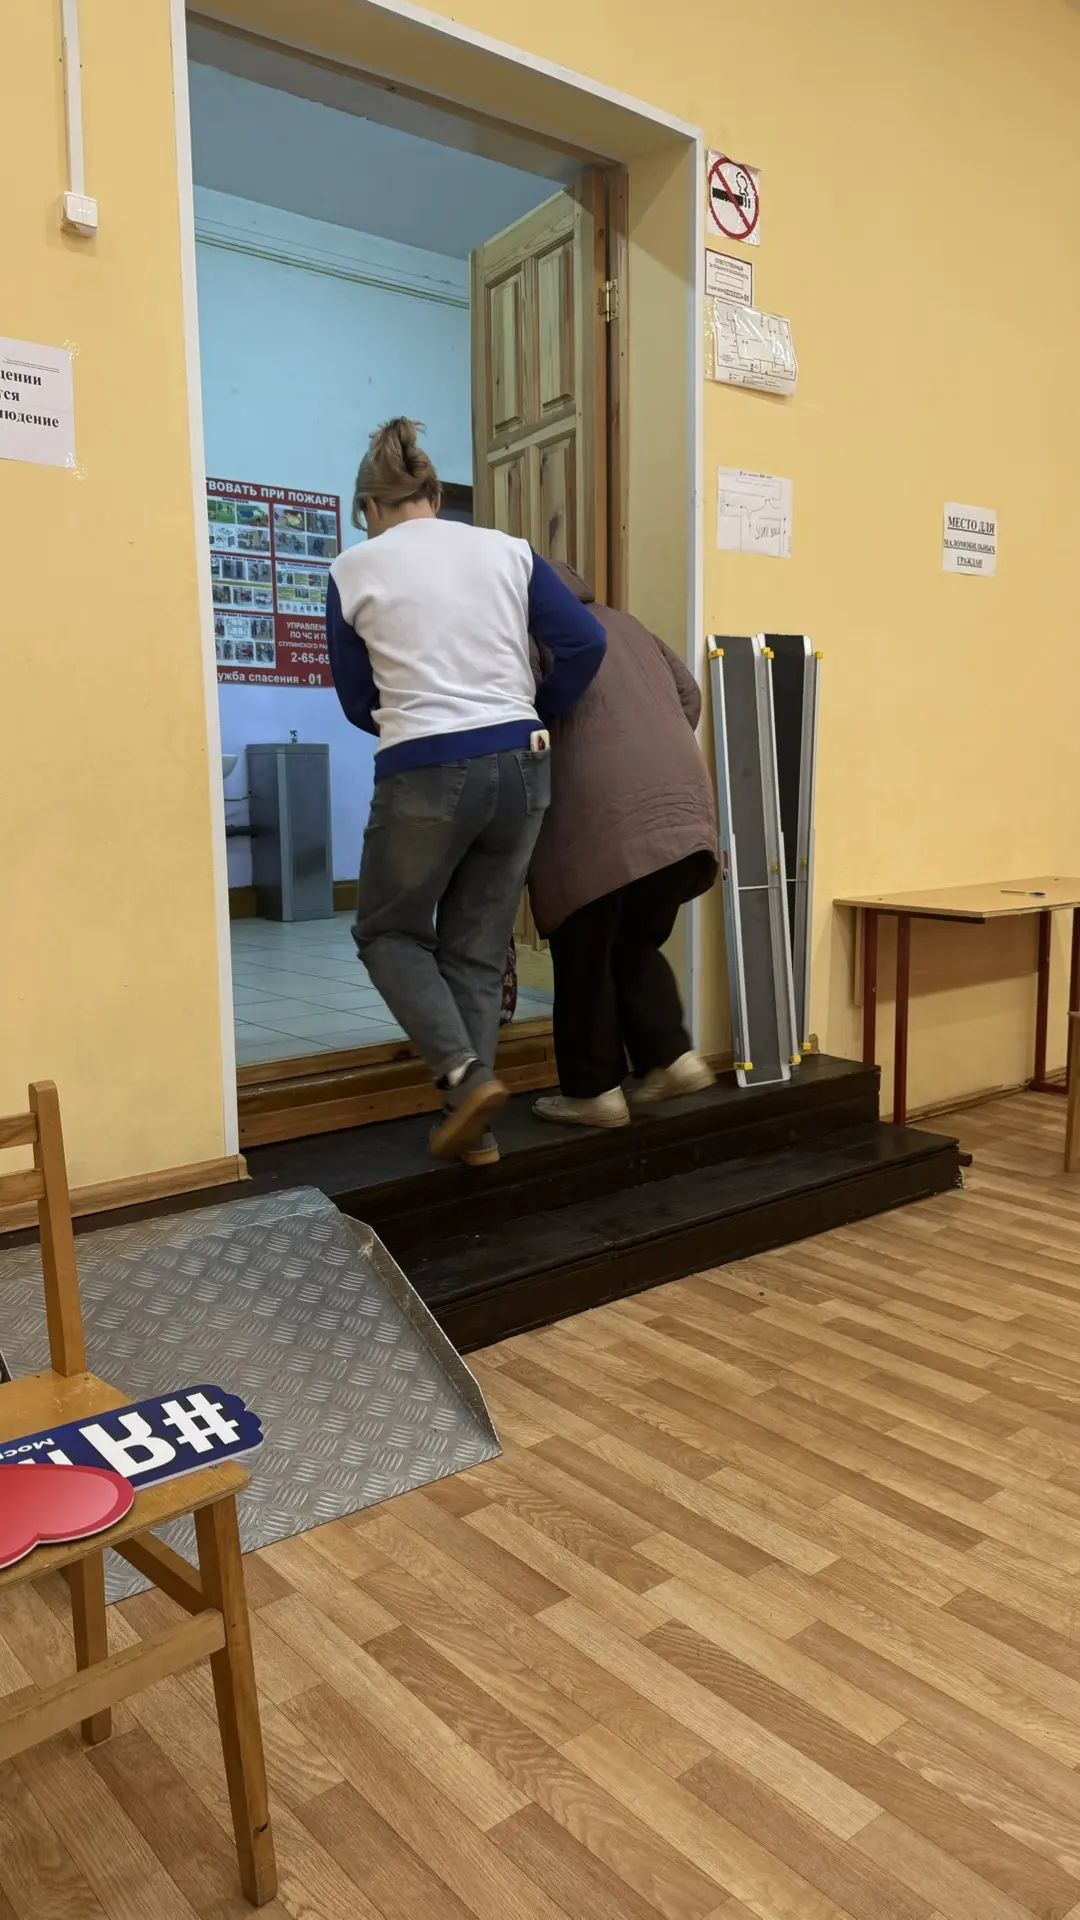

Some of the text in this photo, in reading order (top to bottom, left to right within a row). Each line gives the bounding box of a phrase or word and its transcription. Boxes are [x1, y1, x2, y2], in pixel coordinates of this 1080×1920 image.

[206, 480, 337, 507] ВОВАТЬ ПРИ ПОЖАРЕ
[948, 516, 995, 535] МЕСТО ДЛЯ
[290, 631, 301, 639] ПО
[302, 632, 313, 640] ЧС
[314, 632, 320, 640] И
[248, 673, 299, 684] спасения
[308, 673, 322, 685] 01
